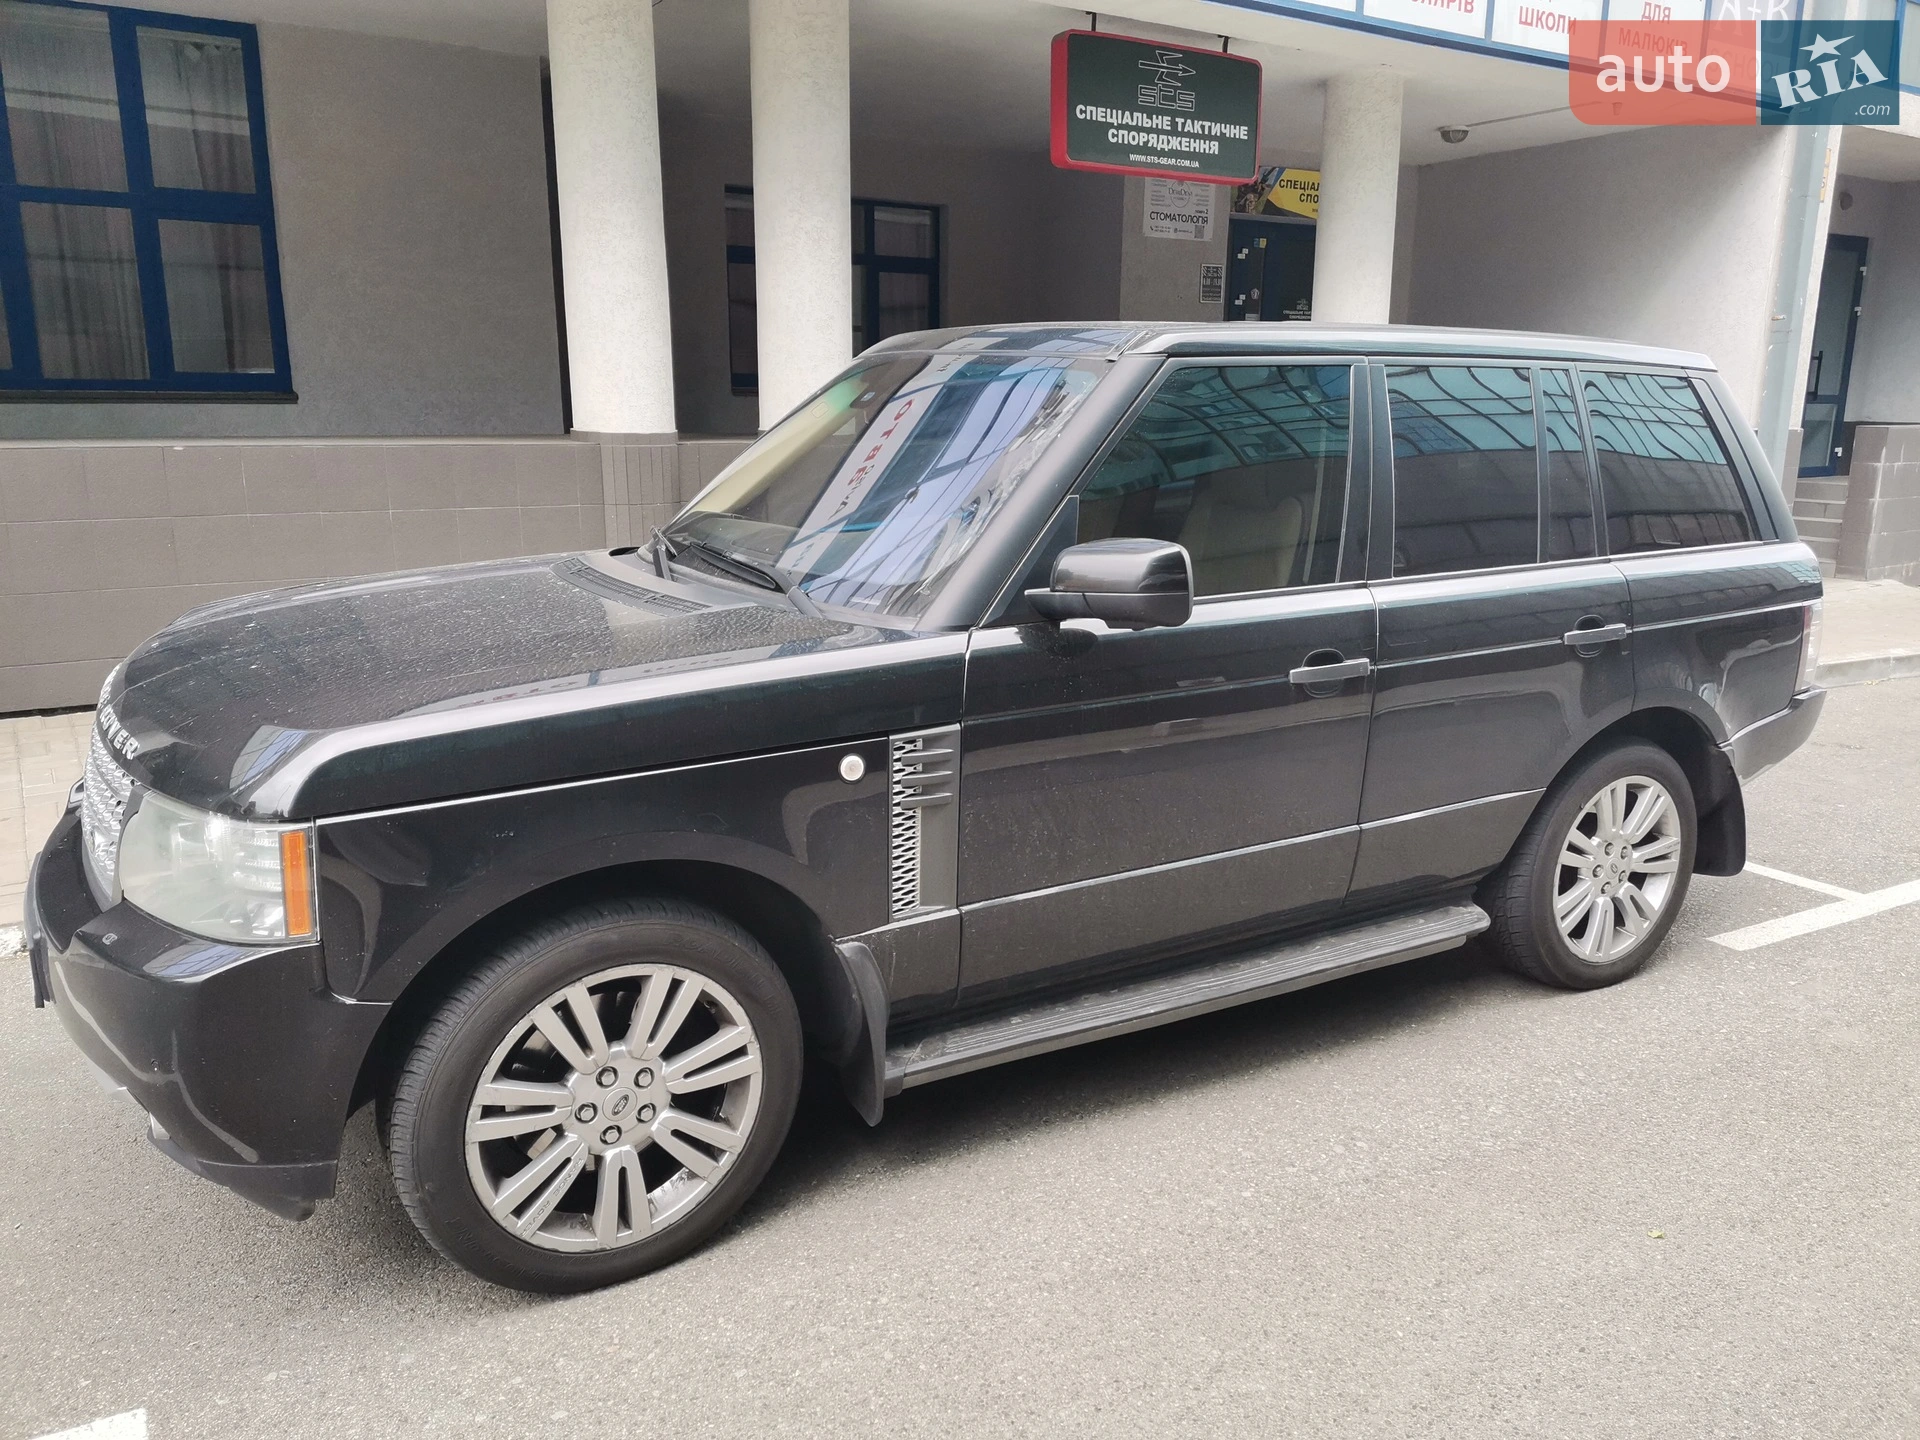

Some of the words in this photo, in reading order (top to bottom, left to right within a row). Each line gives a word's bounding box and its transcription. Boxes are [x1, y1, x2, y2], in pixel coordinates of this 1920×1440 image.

[1519, 6, 1577, 35] ШКОЛИ
[1641, 1, 1671, 24] ДЛЯ
[1619, 27, 1688, 56] МАЛЮКІВ
[1075, 104, 1171, 130] СПЕЦІАЛЬНЕ
[1177, 117, 1249, 140] ТАКТИЧНЕ
[1107, 129, 1219, 154] СПОРЯДЖЕННЯ
[1129, 153, 1200, 168] WWW.STS-GEAR.COM.UA
[100, 704, 140, 760] ROVER
